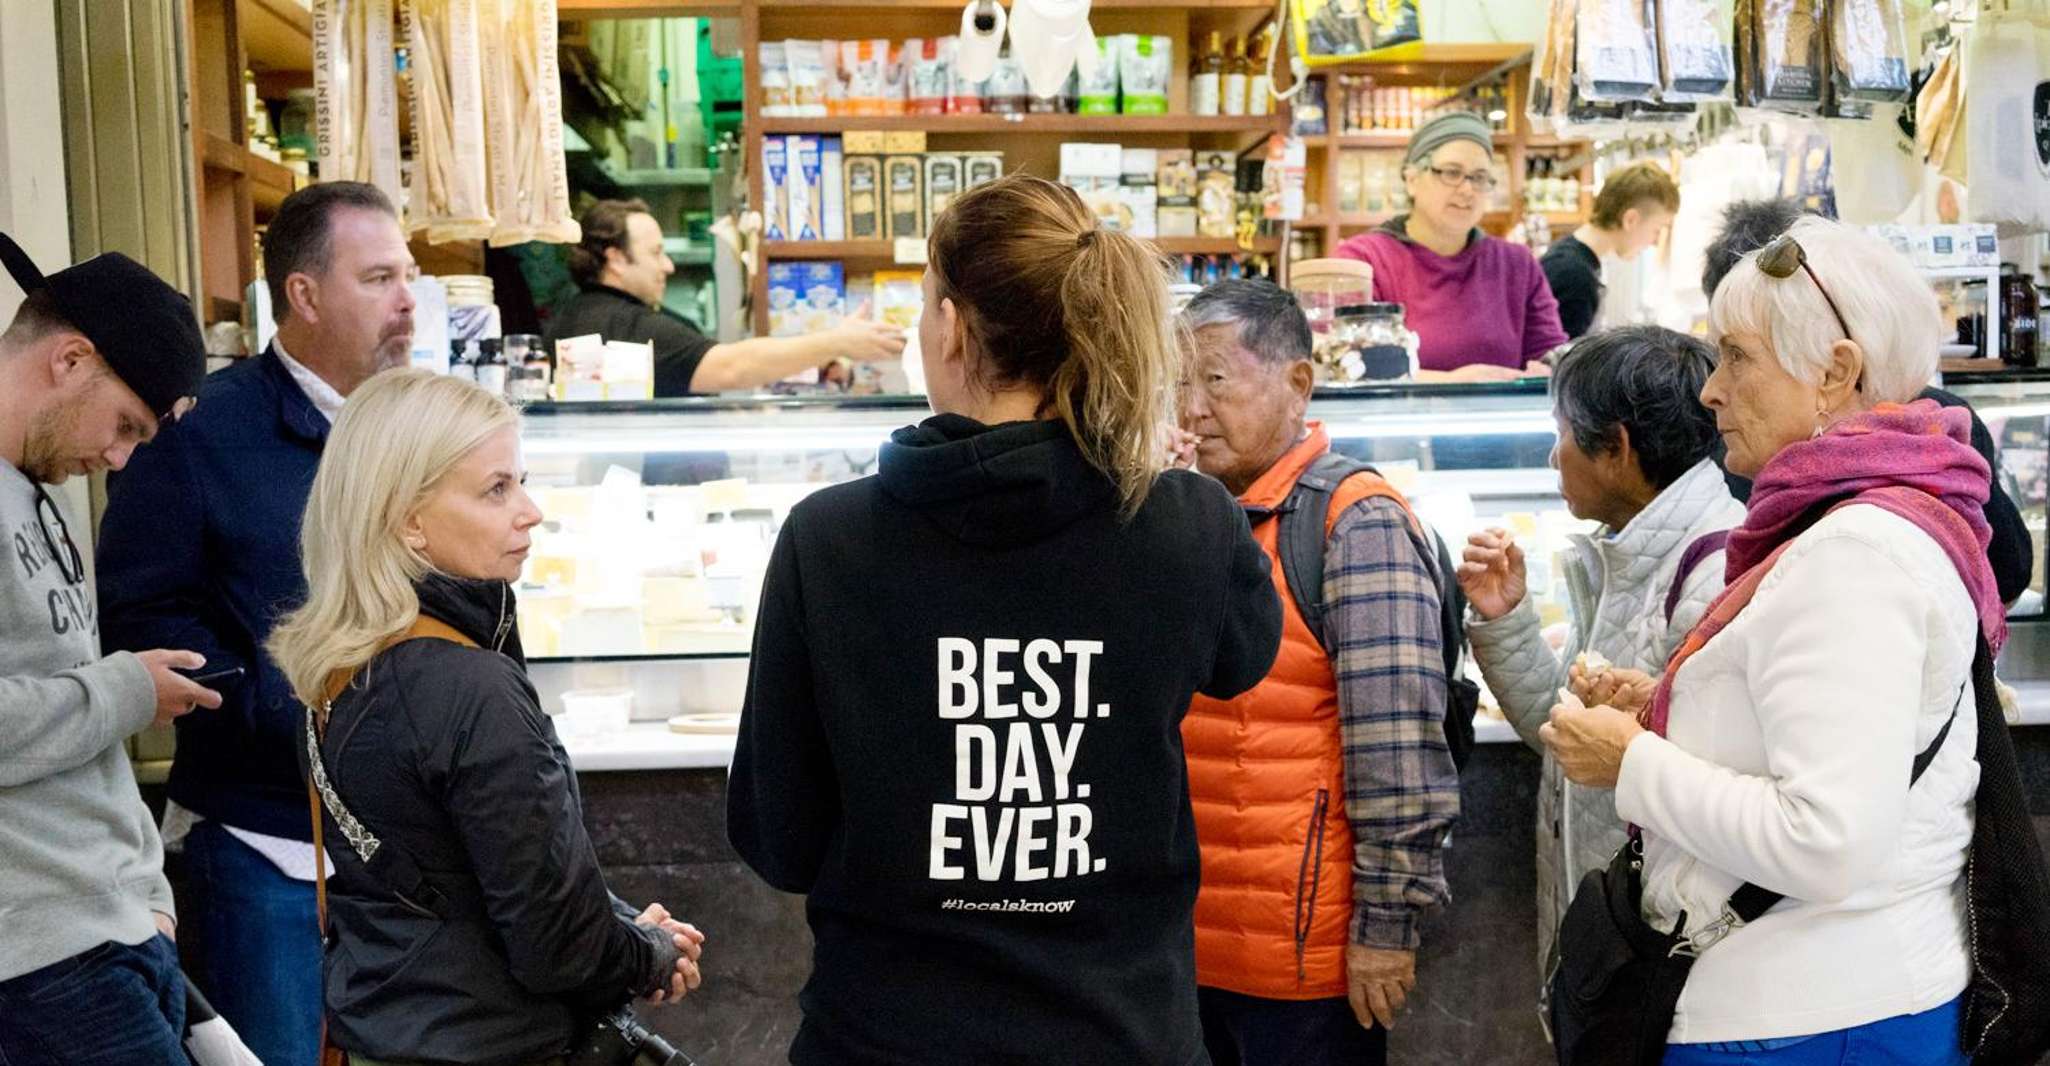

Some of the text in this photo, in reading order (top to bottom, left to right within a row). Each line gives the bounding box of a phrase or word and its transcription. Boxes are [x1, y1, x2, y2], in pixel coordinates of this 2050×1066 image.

[318, 80, 330, 157] GRISSINI
[547, 87, 564, 201] ARTIGIANALI
[937, 637, 1110, 719] BEST.
[955, 722, 1091, 802] DAY.
[929, 803, 1107, 881] EVER.
[941, 899, 1075, 913] #localsknow
